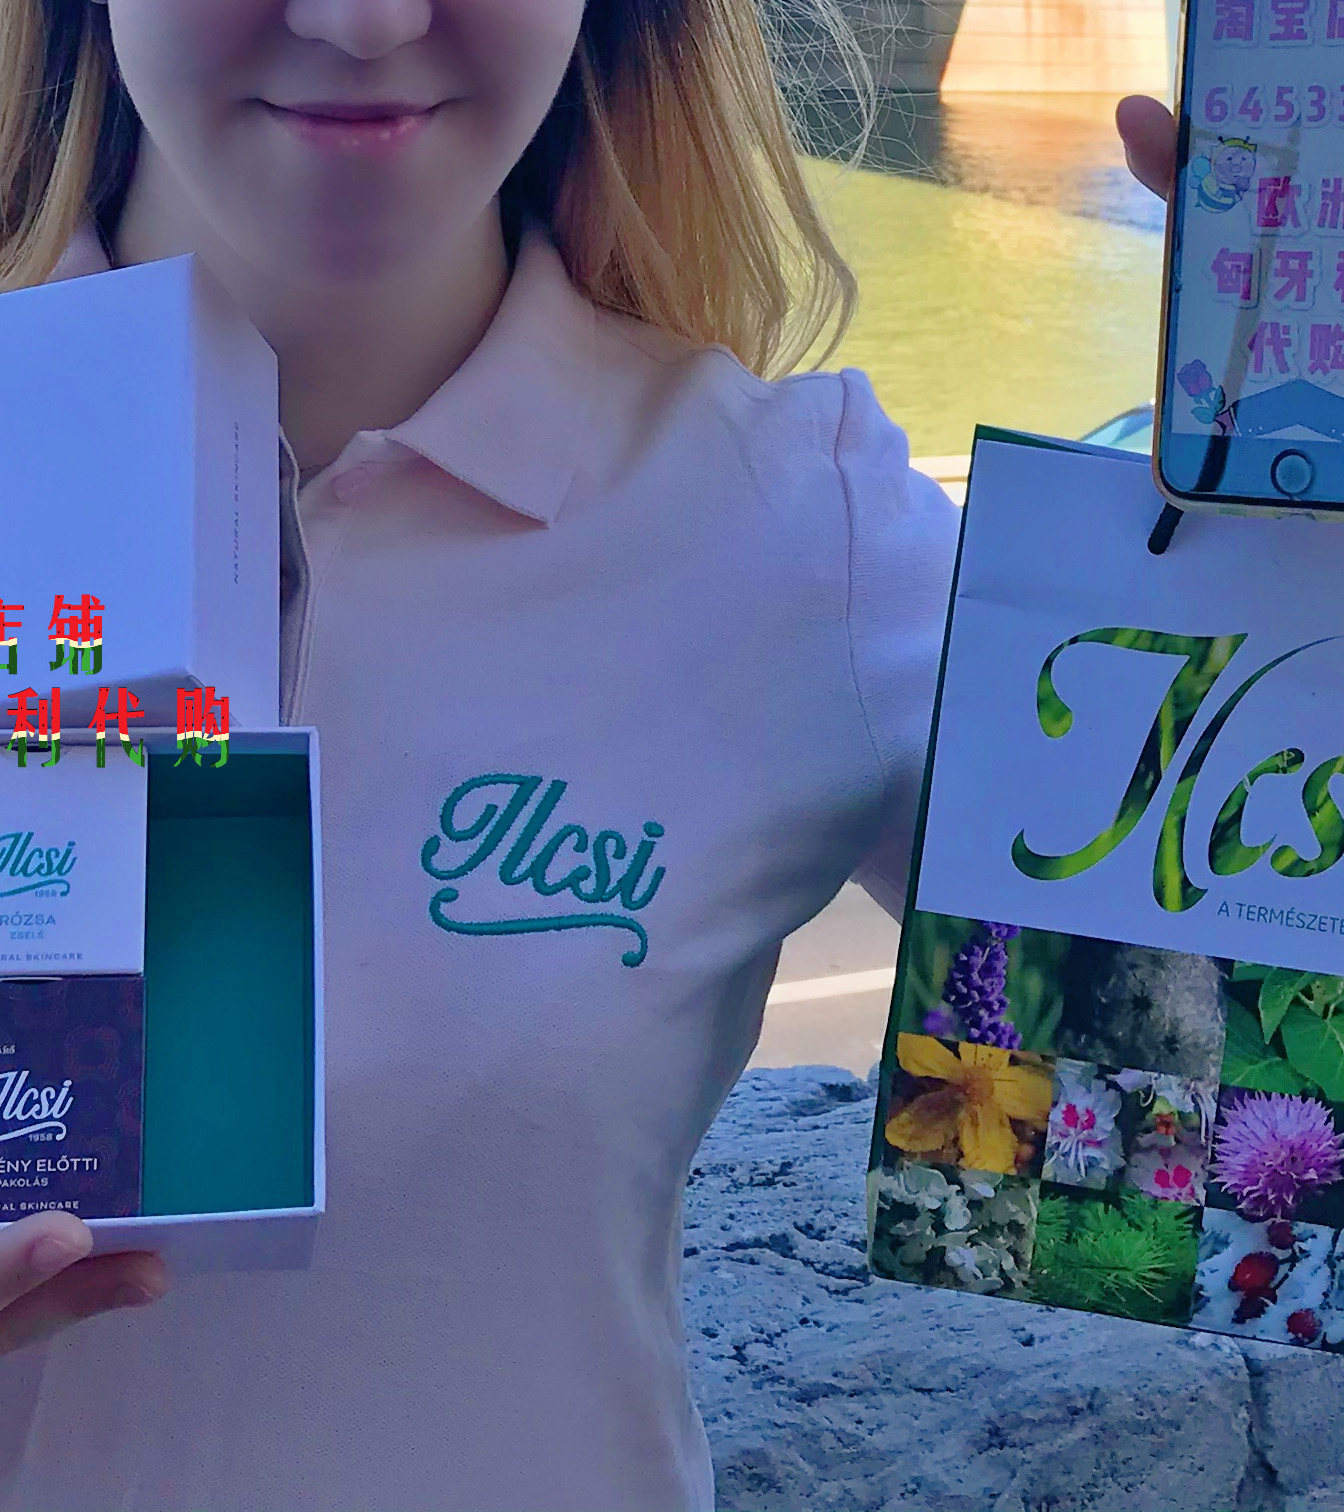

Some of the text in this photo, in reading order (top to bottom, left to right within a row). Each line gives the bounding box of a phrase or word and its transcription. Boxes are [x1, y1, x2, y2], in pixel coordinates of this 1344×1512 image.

[420, 773, 666, 911] Ilcsi
[1217, 901, 1230, 917] A
[0, 911, 56, 926] RÓZSA
[36, 1154, 98, 1172] ELŐTTI
[19, 1200, 79, 1211] SKINCARE
